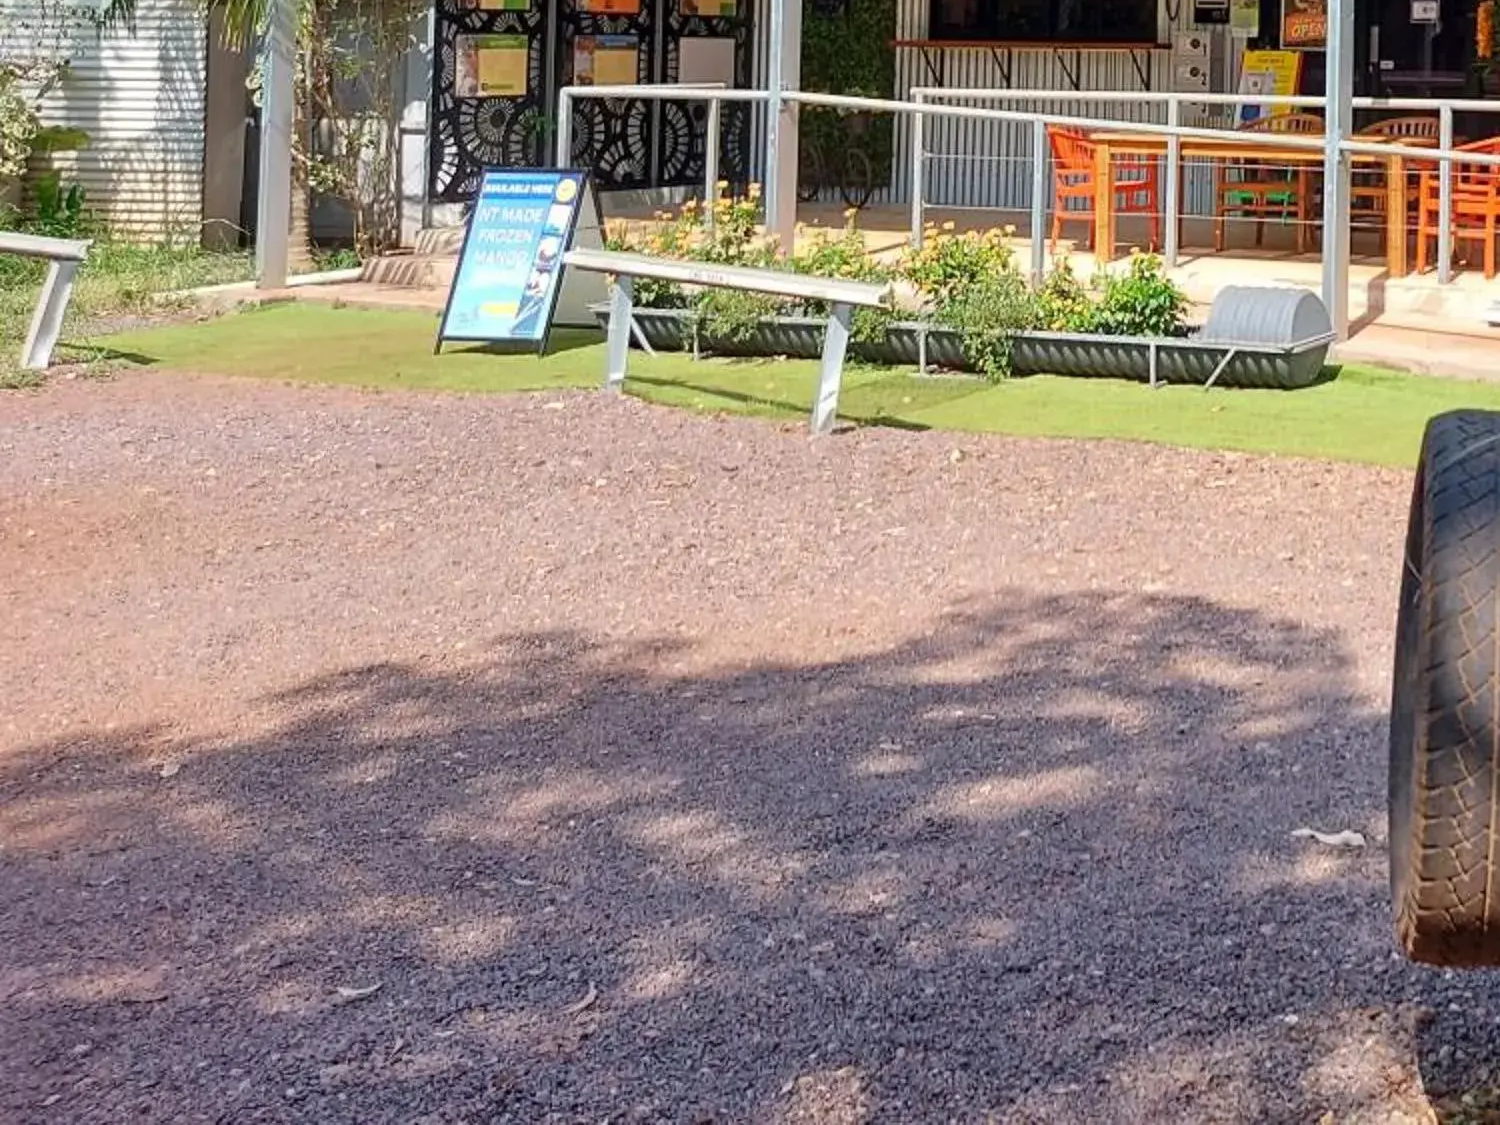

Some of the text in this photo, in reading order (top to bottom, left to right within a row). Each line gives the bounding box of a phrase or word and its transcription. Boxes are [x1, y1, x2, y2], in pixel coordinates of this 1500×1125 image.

[1291, 22, 1327, 39] OPEN
[478, 206, 544, 224] NT MADE
[477, 228, 534, 244] FROZEN
